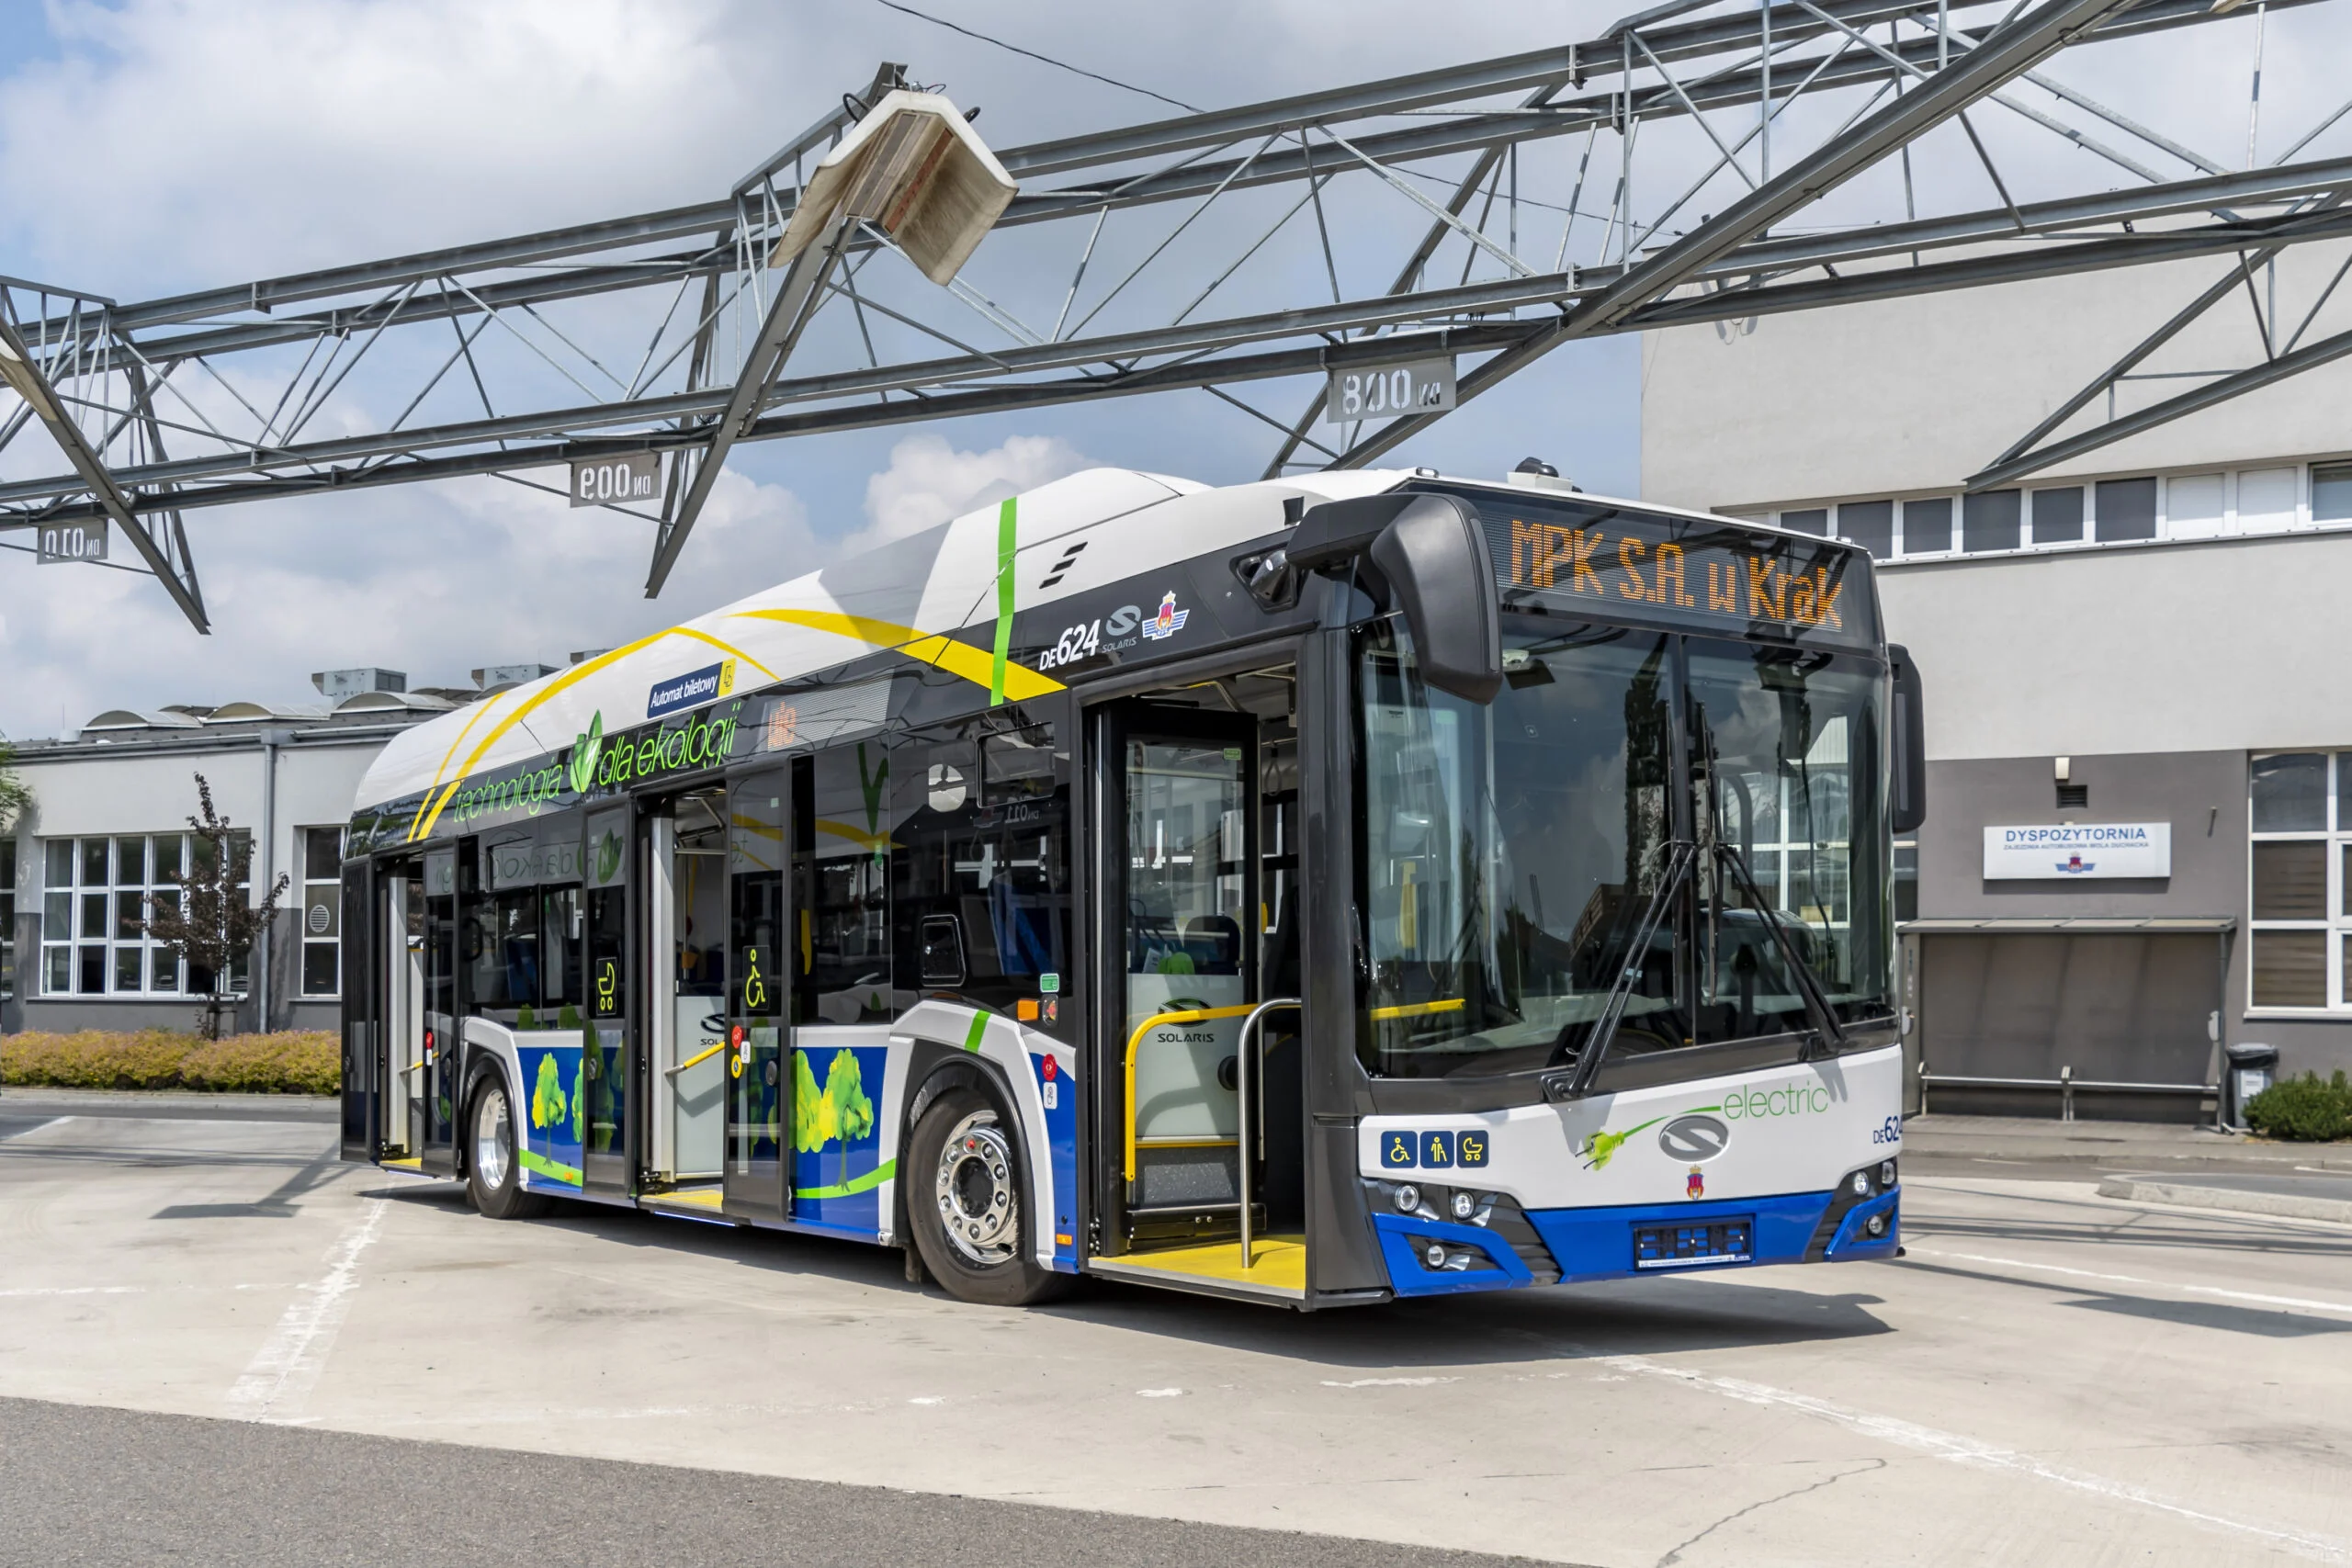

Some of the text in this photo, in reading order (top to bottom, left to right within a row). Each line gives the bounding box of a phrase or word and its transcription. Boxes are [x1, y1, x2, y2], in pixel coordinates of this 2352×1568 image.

[1512, 520, 1843, 628] MPK S.A. w Krak
[1102, 637, 1138, 654] SOLARIS
[650, 675, 718, 708] Automat biletowy
[453, 756, 563, 824] technologia
[597, 735, 635, 786] dla
[636, 702, 741, 773] ekologii
[2006, 828, 2146, 841] DYSPOZYTORNIA
[1158, 1033, 1215, 1043] SOLARIS
[1724, 1080, 1828, 1121] electric
